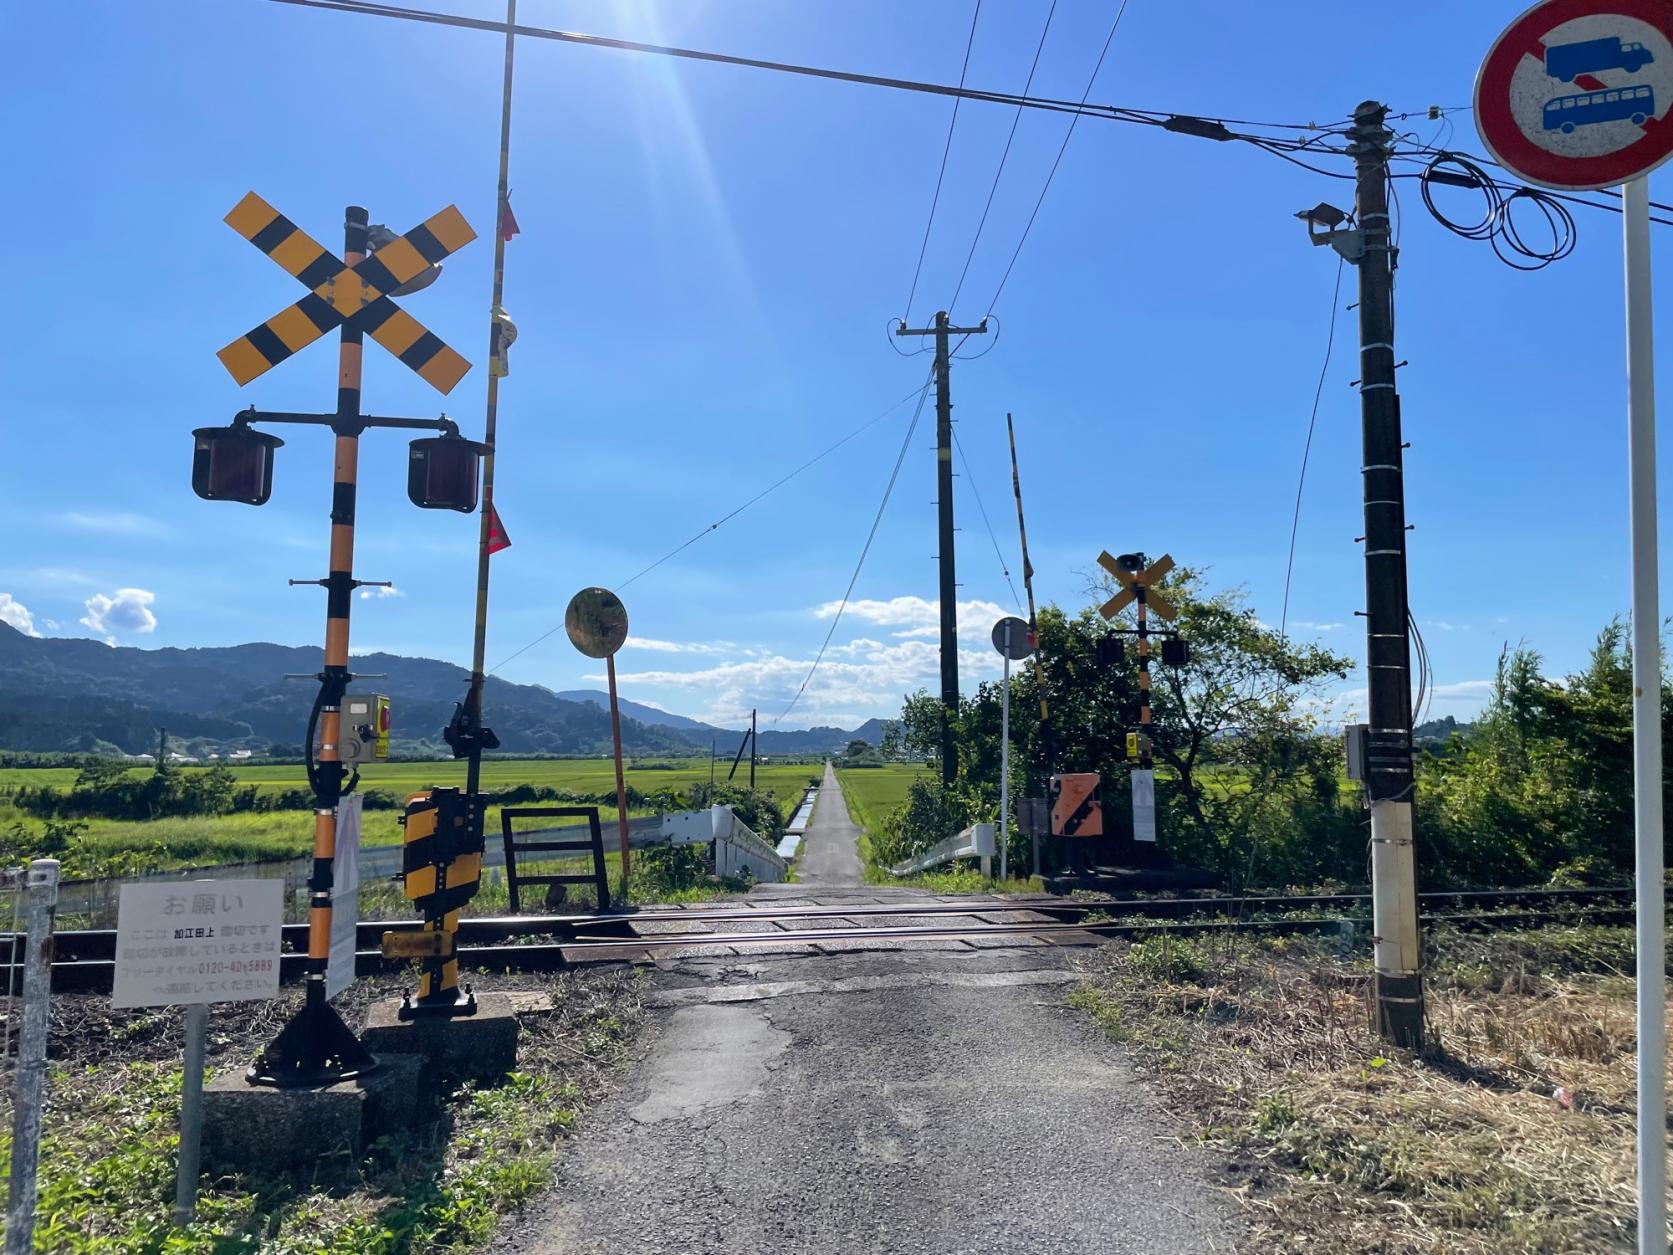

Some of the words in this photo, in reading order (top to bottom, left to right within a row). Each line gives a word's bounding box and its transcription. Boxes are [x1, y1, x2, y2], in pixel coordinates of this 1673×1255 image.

[163, 893, 244, 916] お願い
[173, 926, 215, 940] 加江田上
